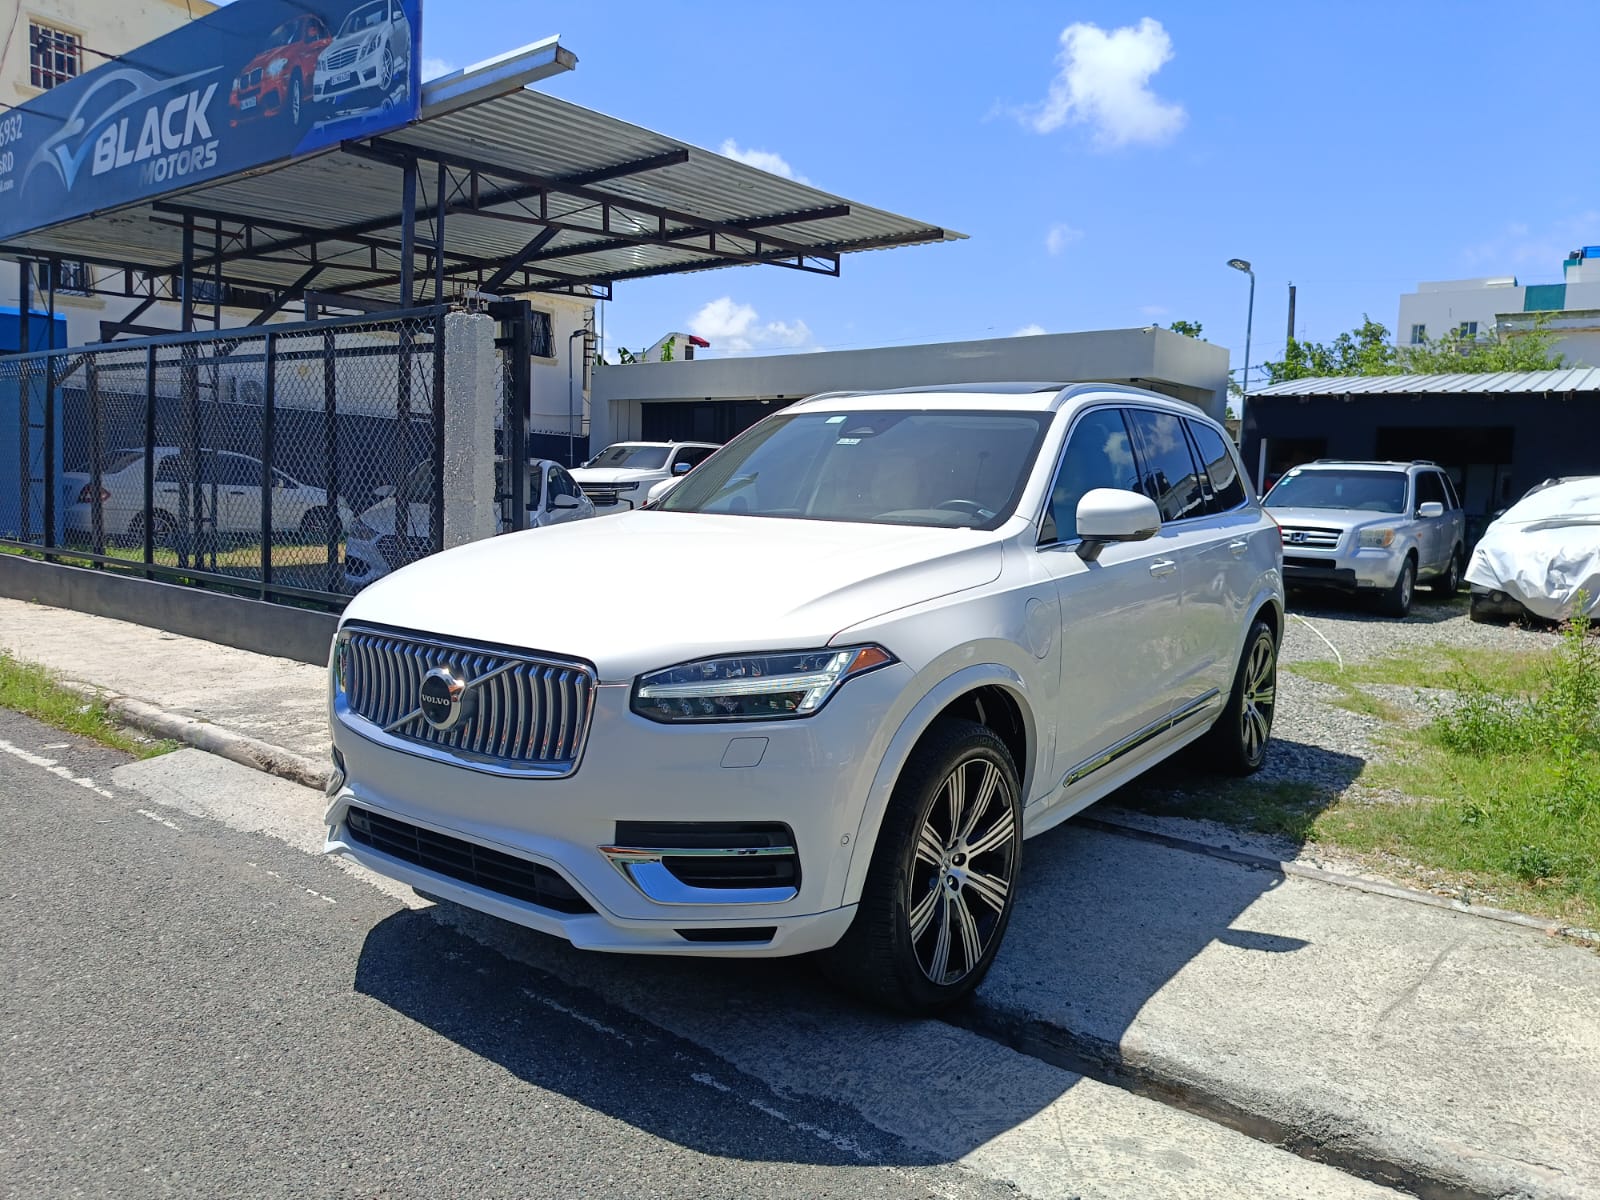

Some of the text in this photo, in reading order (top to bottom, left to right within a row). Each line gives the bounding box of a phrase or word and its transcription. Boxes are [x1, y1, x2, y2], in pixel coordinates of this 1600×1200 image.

[92, 82, 219, 176] BLACK
[139, 140, 219, 187] MOTORS
[422, 694, 450, 706] VOLVO
